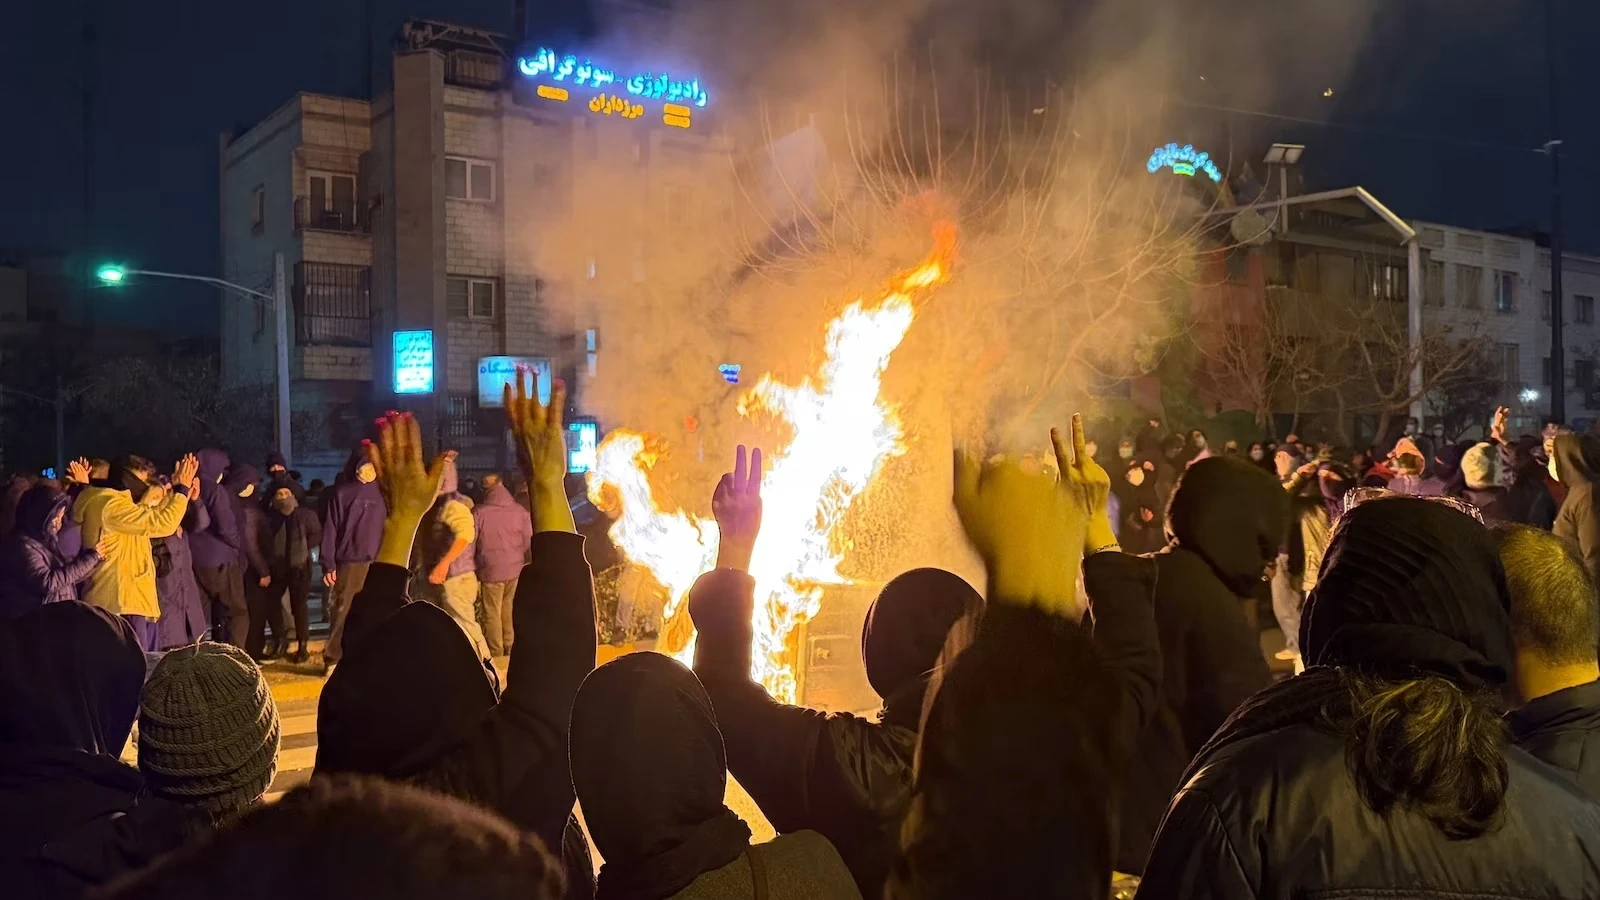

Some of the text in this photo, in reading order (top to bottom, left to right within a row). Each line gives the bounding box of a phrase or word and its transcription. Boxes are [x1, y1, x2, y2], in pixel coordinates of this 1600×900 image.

[518, 48, 615, 88] سونوگرافی
[588, 93, 645, 119] مرزداران
[627, 72, 708, 107] رادیولوژی
